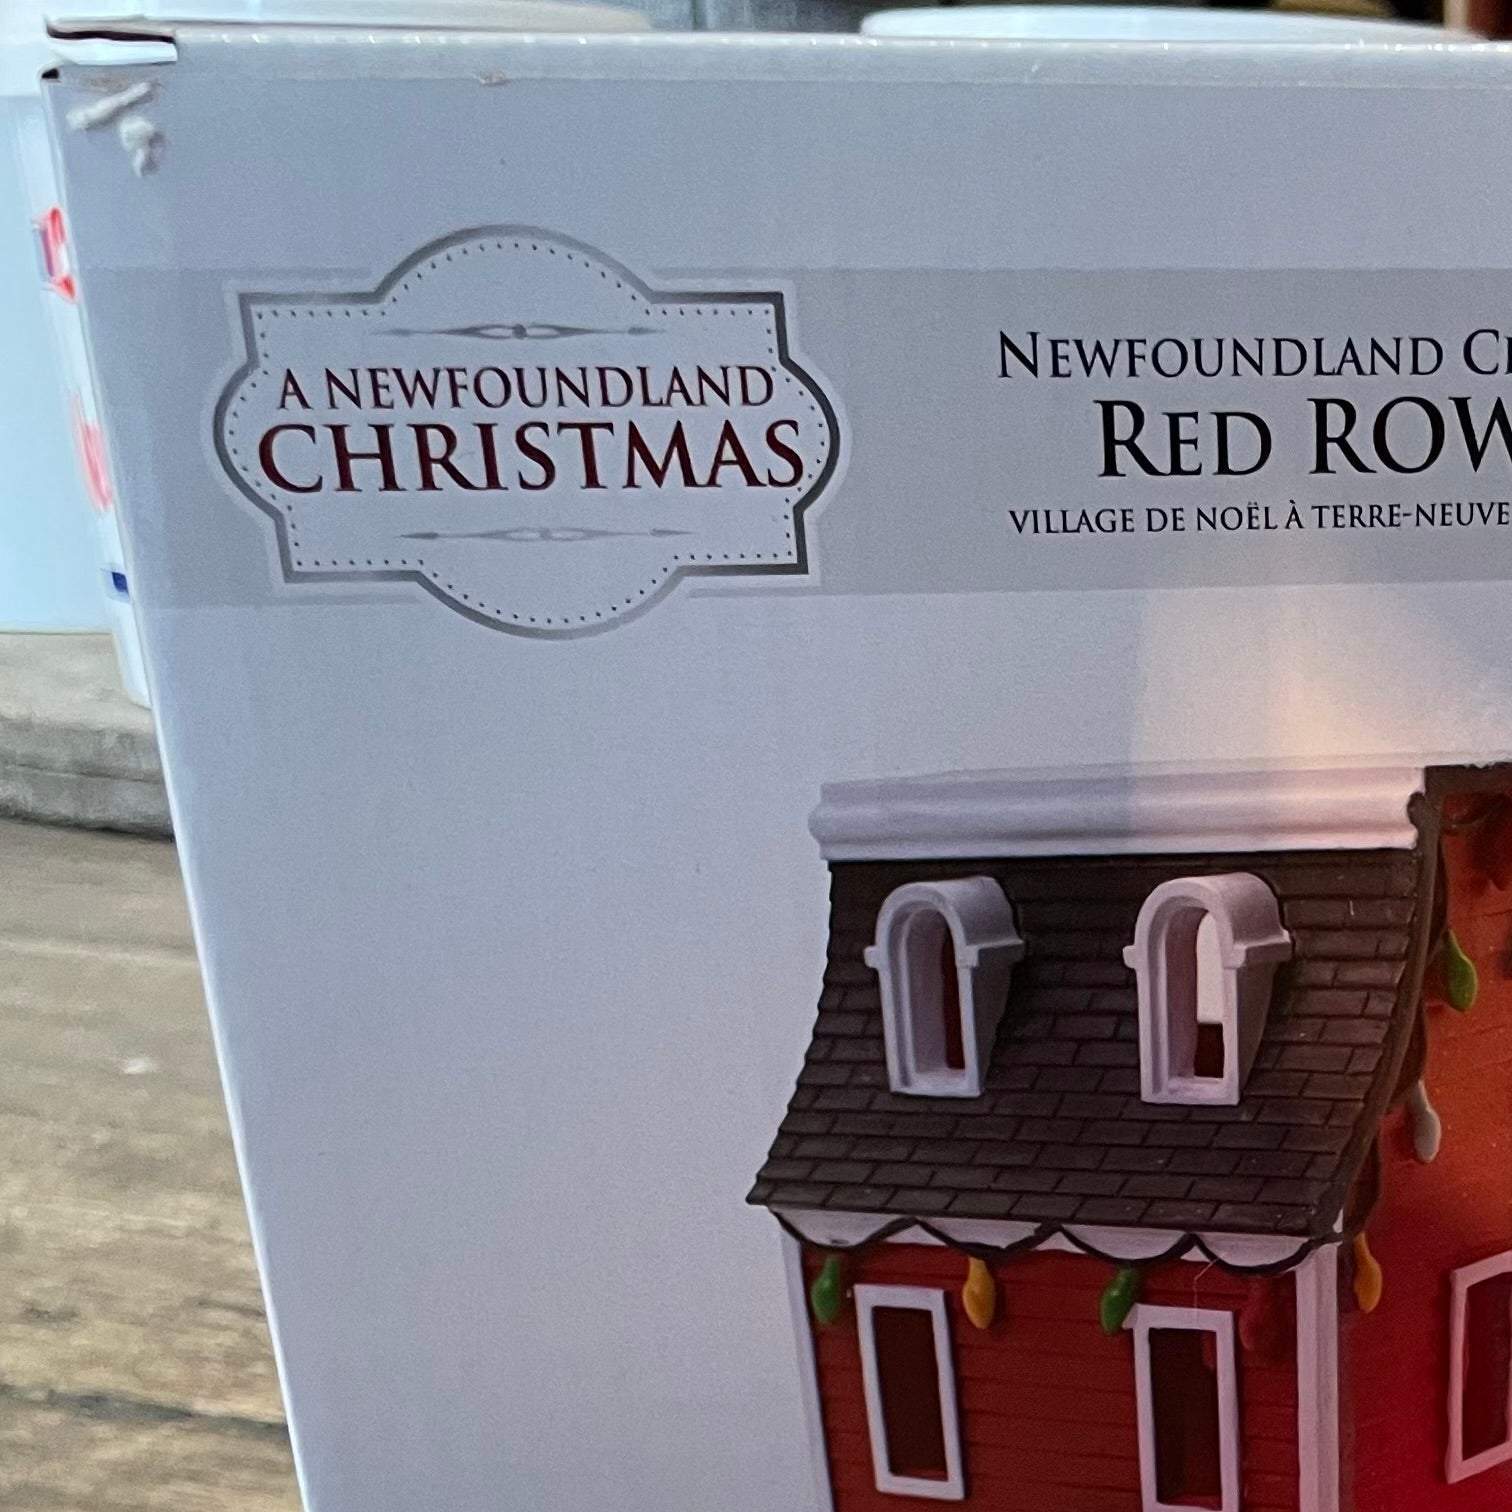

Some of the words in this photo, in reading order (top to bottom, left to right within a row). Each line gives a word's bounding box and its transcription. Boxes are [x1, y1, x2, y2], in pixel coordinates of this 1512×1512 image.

[998, 331, 1444, 378] NEWFOUNDLAND
[277, 368, 314, 410] A
[324, 365, 775, 409] NEWFOUNDLAND
[258, 420, 804, 493] CHRISTMAS
[1093, 399, 1272, 478] RED
[1008, 508, 1135, 534] VILLAGE
[1145, 507, 1186, 532] DE
[1197, 499, 1278, 531] NOËL
[1284, 499, 1305, 530] À
[1311, 501, 1511, 530] TERRE-NEUVE
